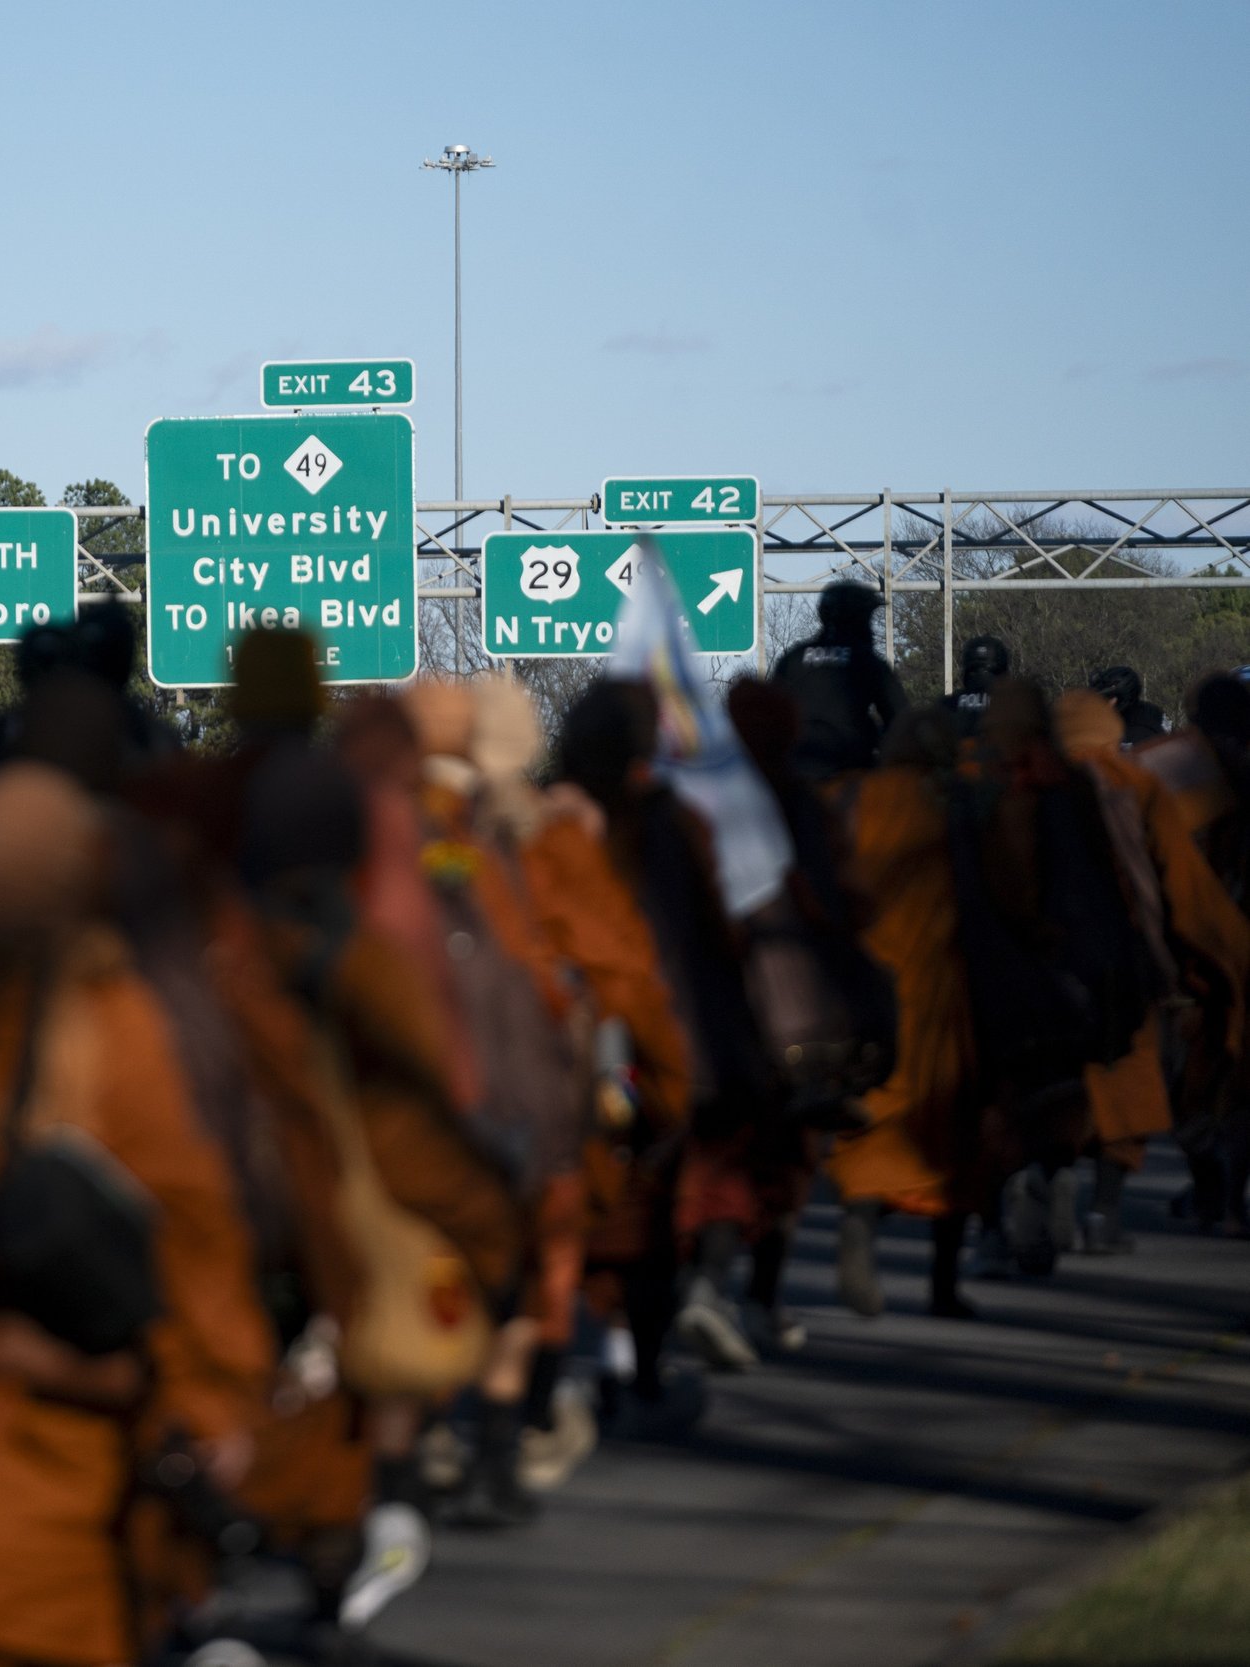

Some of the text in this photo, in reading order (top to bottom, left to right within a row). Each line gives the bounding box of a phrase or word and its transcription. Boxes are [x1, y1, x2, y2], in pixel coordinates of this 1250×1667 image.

[278, 369, 397, 397] EXIT 43
[216, 452, 327, 481] TO 49
[620, 486, 740, 513] EXIT 42
[172, 505, 388, 540] University
[193, 553, 371, 592] City Blvd
[528, 560, 572, 590] 29
[165, 598, 401, 631] TO Ikea Blvd
[495, 616, 628, 651] N Tryo
